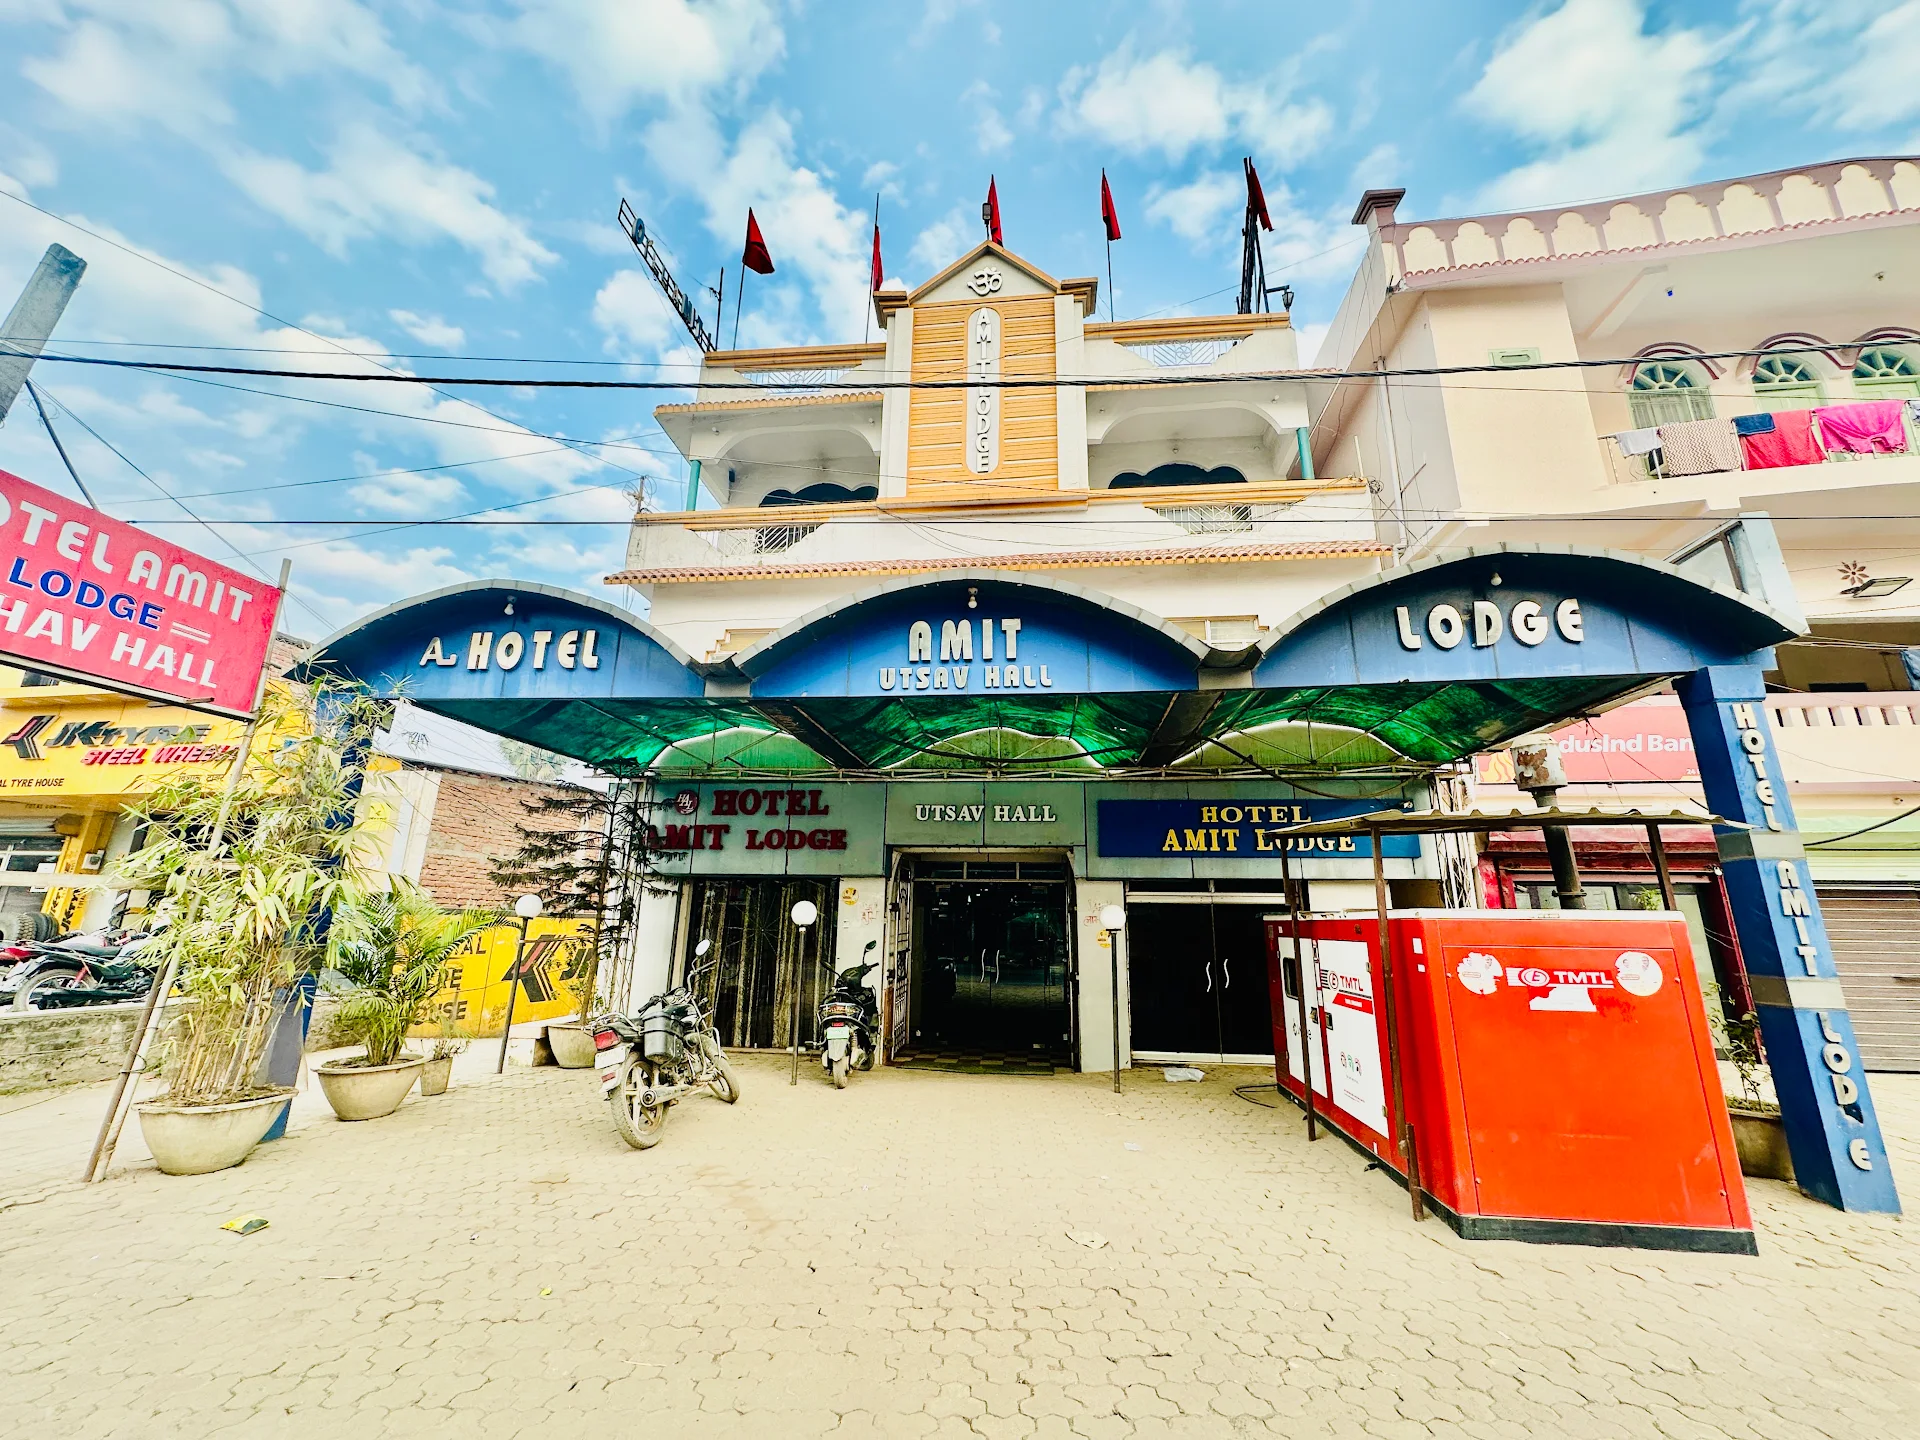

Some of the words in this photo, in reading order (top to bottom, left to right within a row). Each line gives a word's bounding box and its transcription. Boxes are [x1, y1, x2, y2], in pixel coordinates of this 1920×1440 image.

[975, 383, 991, 473] LODGE
[7, 556, 165, 630] LODGE
[128, 549, 252, 622] AMIT
[1395, 598, 1585, 650] LODGE
[466, 630, 599, 670] HOTEL
[908, 618, 1021, 662] AMIT
[111, 631, 217, 689] HALL
[879, 666, 970, 690] UTSAV
[984, 665, 1052, 688] HALL
[81, 748, 146, 765] STEEL
[1558, 734, 1642, 753] dusInd
[1647, 735, 1695, 752] Ban
[1732, 703, 1782, 831] HOTEL
[11, 778, 34, 788] TYRE
[35, 778, 65, 787] HOUSE
[712, 789, 829, 816] HOTEL
[915, 804, 985, 822] UTSAV
[994, 805, 1056, 822] HALL
[1201, 806, 1311, 823] HOTEL
[642, 825, 730, 850] AMIT
[746, 829, 847, 850] LODGE
[1162, 828, 1240, 852] AMIT
[1776, 860, 1817, 977] AMIT
[1340, 975, 1363, 992] TMTL
[1553, 971, 1614, 985] TMTL
[1817, 1012, 1873, 1171] LODE
